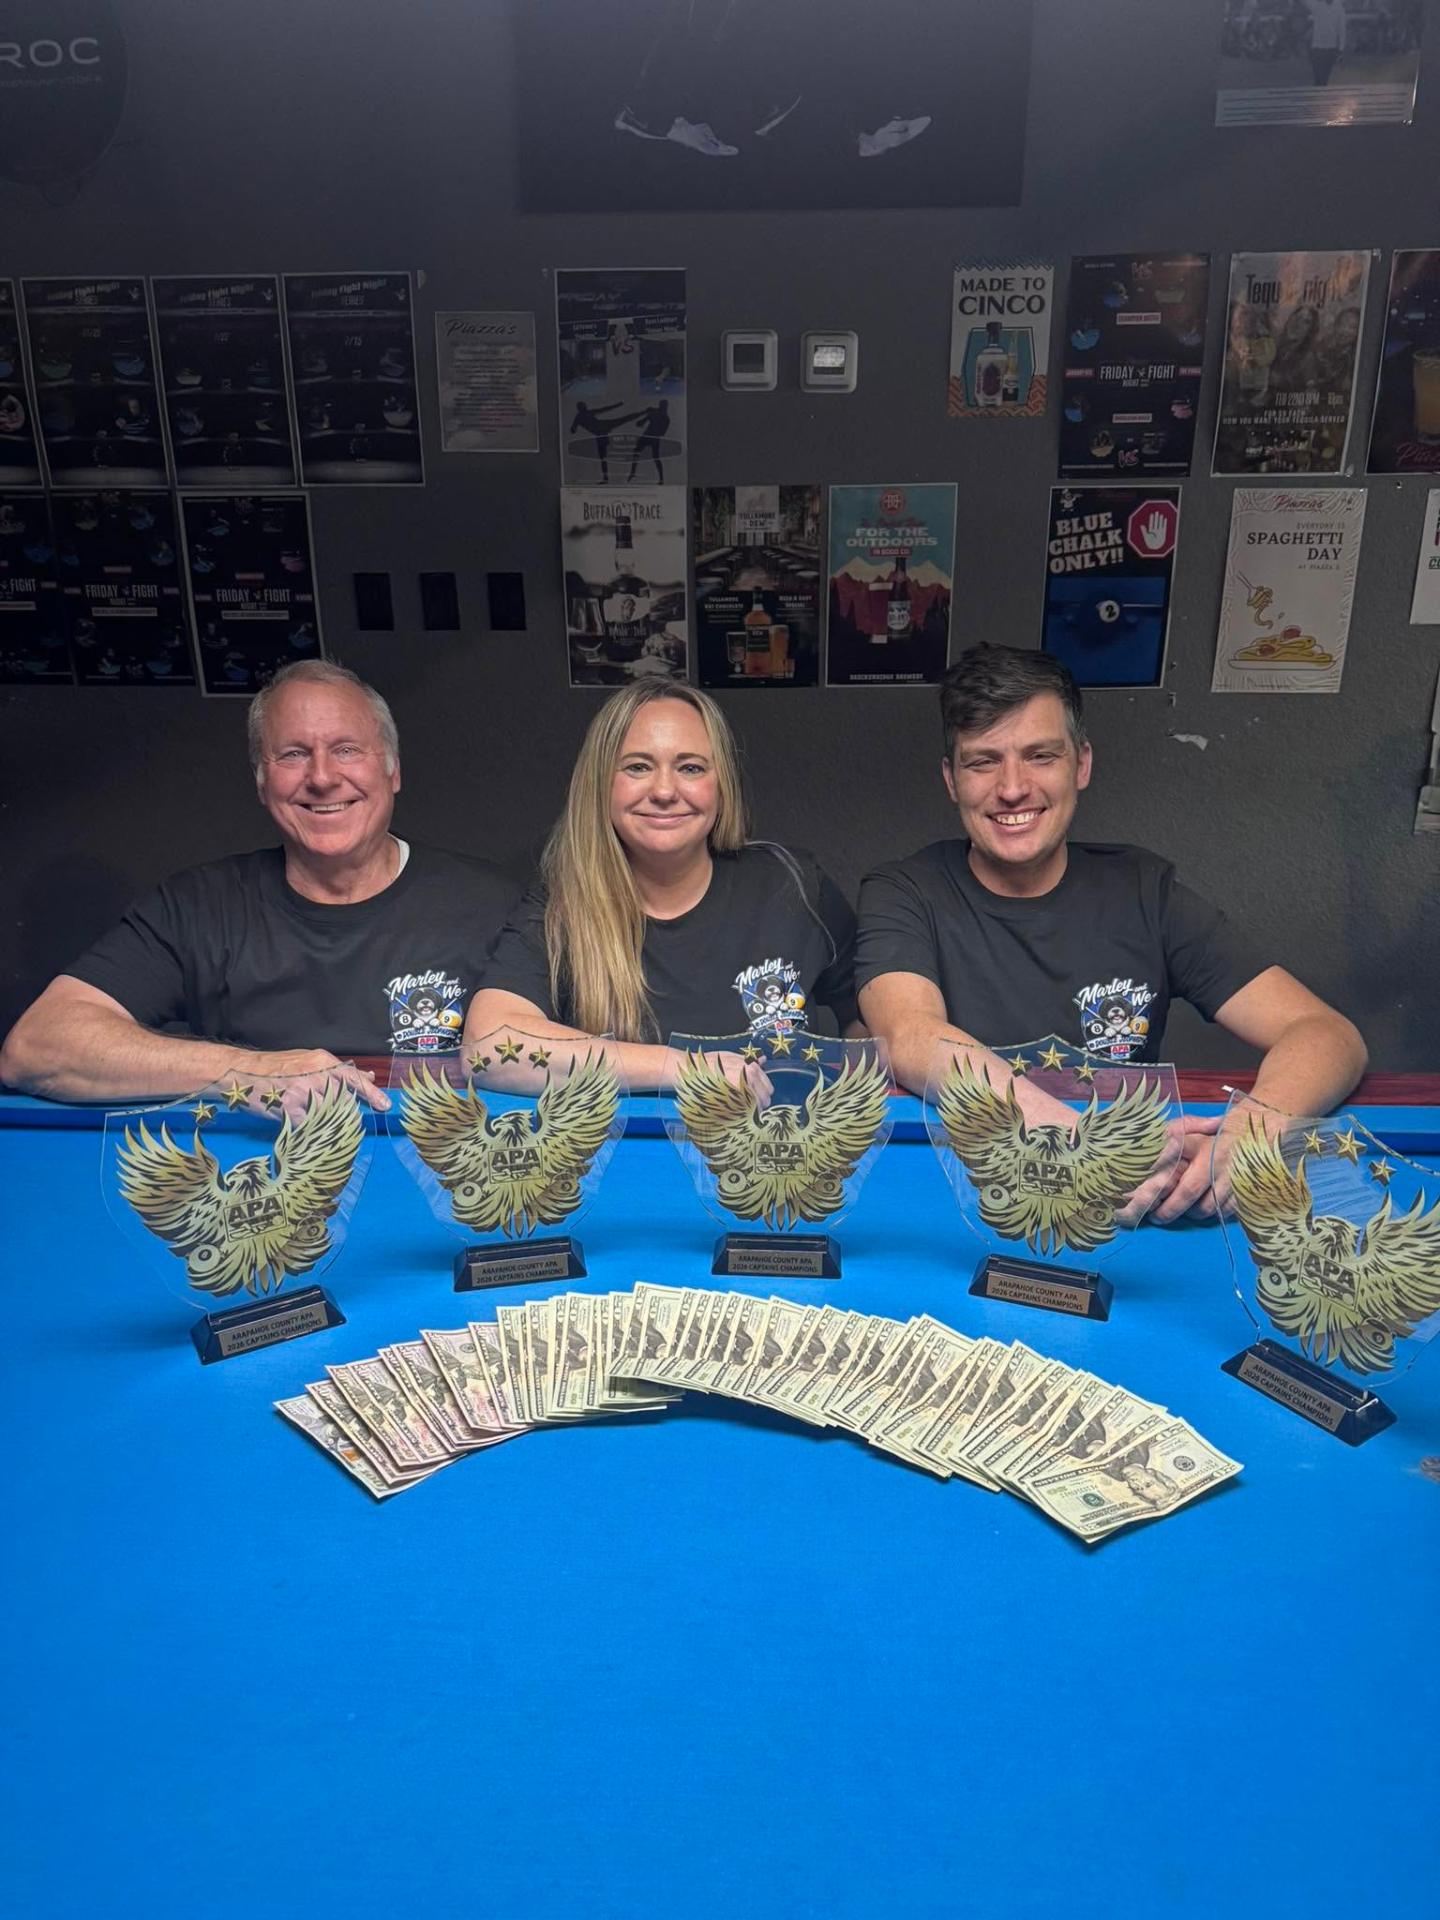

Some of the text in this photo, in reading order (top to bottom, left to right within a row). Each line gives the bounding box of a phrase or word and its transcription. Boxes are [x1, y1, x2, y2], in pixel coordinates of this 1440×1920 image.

[960, 276, 1046, 293] MADE TO
[958, 294, 1046, 316] CINCO
[1099, 366, 1135, 380] FRIDAY
[1148, 365, 1176, 379] FIGHT
[583, 501, 662, 521] BUFFALO TRACE
[855, 527, 929, 537] FOR THE
[1056, 512, 1112, 536] BLUE
[846, 537, 939, 548] OUTDOORS
[1049, 528, 1122, 556] CHALK
[1247, 532, 1345, 545] SPAGHETTI
[1050, 547, 1124, 574] ONLY!!
[1307, 547, 1342, 561] DAY
[9, 578, 37, 593] FIGHT
[85, 584, 159, 599] FRIDAY FIGHT
[215, 588, 290, 603] FRIDAY FIGHT
[1105, 604, 1117, 619] 2
[389, 969, 446, 1001] Marley
[735, 957, 784, 994] Marley
[442, 985, 462, 1000] We
[1078, 977, 1133, 1011] Marley
[1132, 990, 1152, 1007] We
[491, 1148, 541, 1167] APA
[757, 1143, 806, 1158] APA
[1022, 1162, 1074, 1182] APA
[228, 1196, 282, 1223] APA
[482, 1265, 515, 1276] ARAPAHOE
[517, 1263, 544, 1271] COUNTY
[738, 1255, 813, 1265] ARAPAHOE COUNTY APA
[749, 1263, 779, 1271] CAPTAINS
[494, 1271, 525, 1282] CAPTAINS
[525, 1268, 564, 1279] CHAMPIONS
[1303, 1253, 1356, 1291] APA
[998, 1280, 1079, 1301] ARAPAHOE COUNTY APA
[1009, 1290, 1041, 1303] CAPTAINS
[1042, 1297, 1084, 1311] CHAMPIONS
[231, 1311, 315, 1341] ARAPAHOE COUNTY APA
[246, 1330, 281, 1347] CAPTAINS
[280, 1319, 323, 1338] CHAMPIONS
[1253, 1364, 1331, 1413] ARAPAHOE COUNTY APA
[1260, 1378, 1292, 1401] CAPTAINS
[1291, 1397, 1334, 1426] CHAMPIONS
